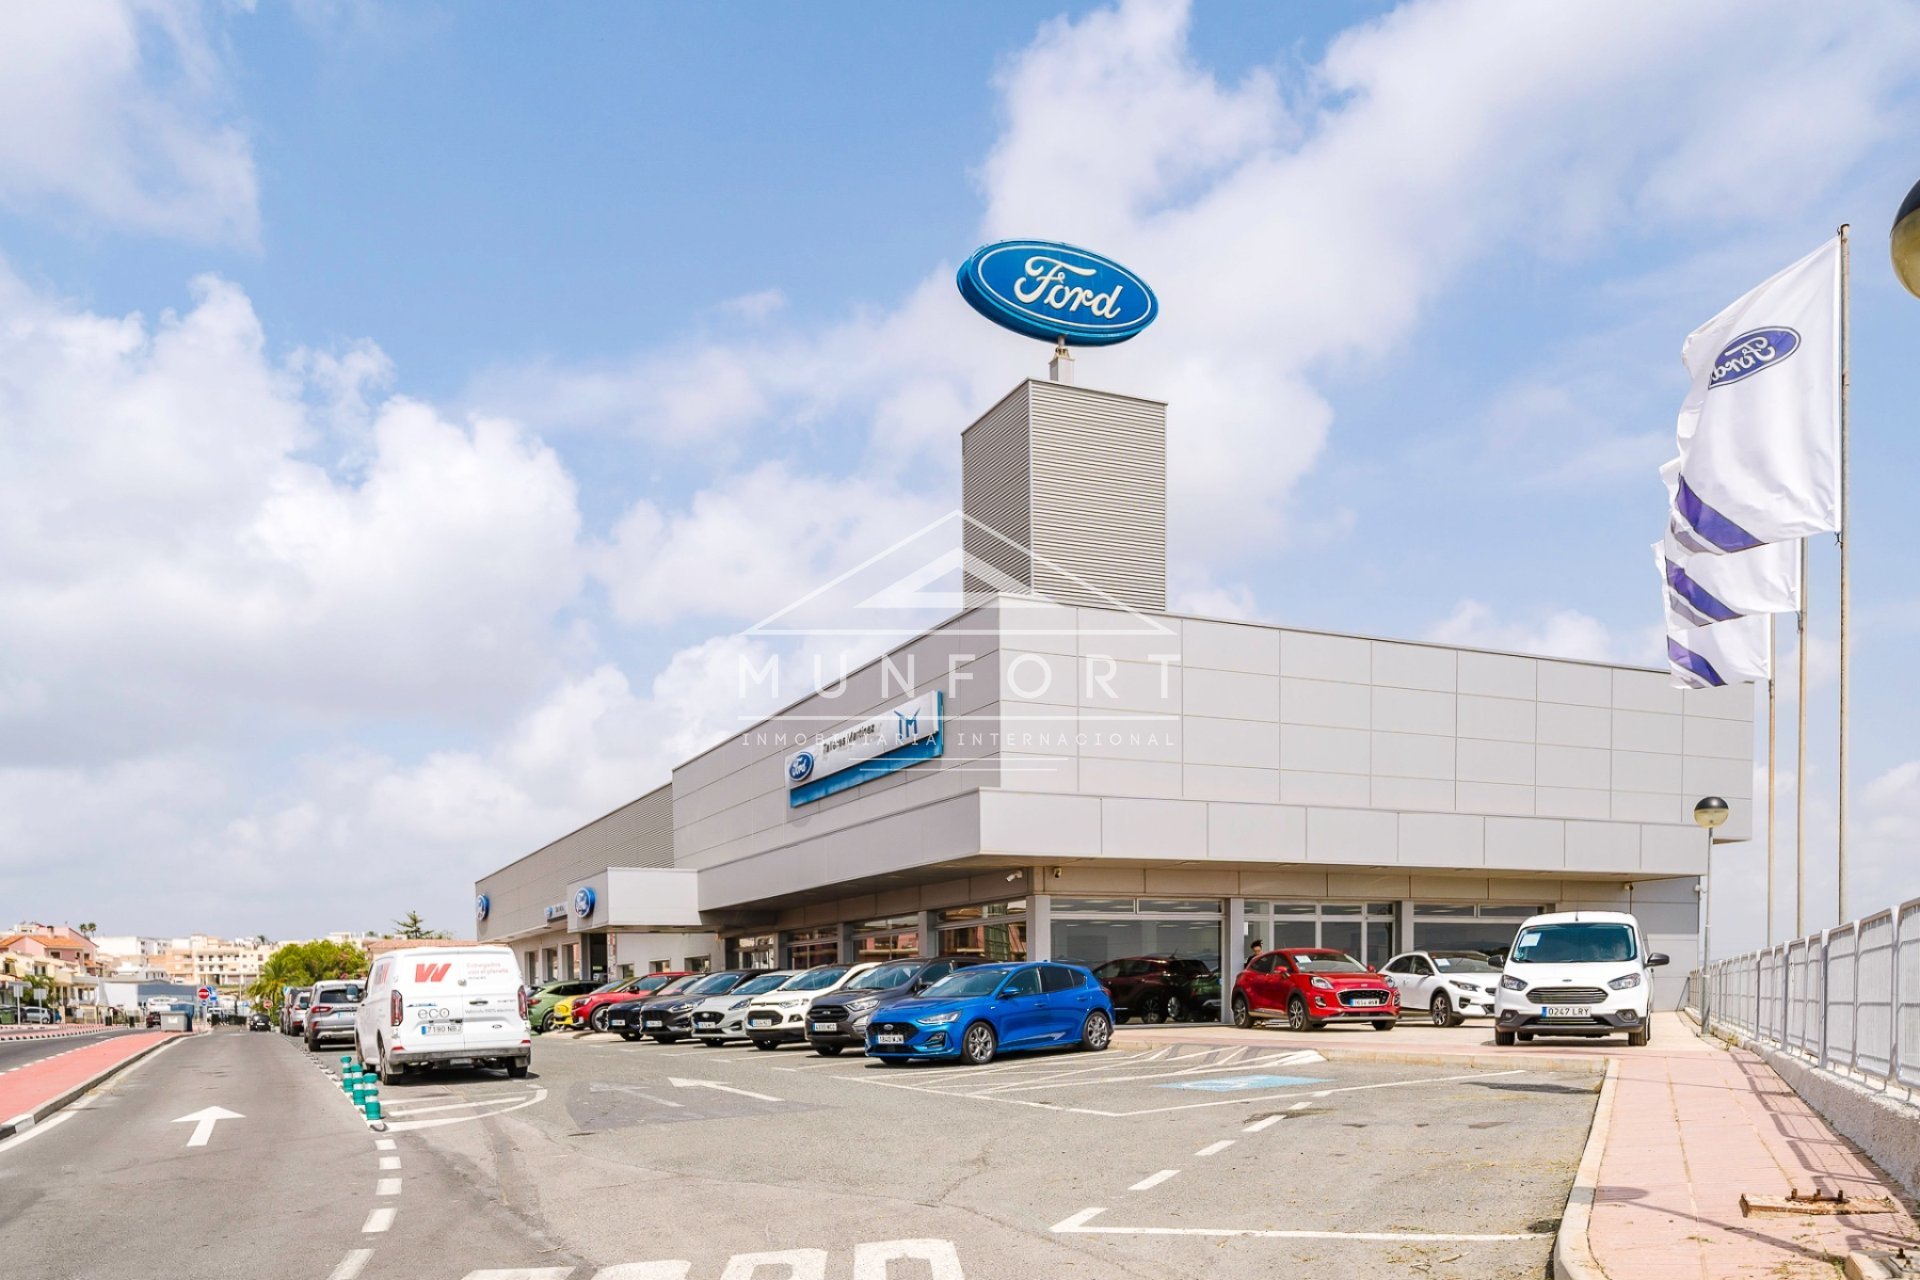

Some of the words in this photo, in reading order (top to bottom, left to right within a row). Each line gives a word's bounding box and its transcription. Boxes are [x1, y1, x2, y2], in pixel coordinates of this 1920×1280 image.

[1014, 256, 1123, 319] Ford
[418, 1008, 450, 1019] eco
[1549, 1007, 1570, 1016] 0247
[1572, 1007, 1589, 1016] LRY
